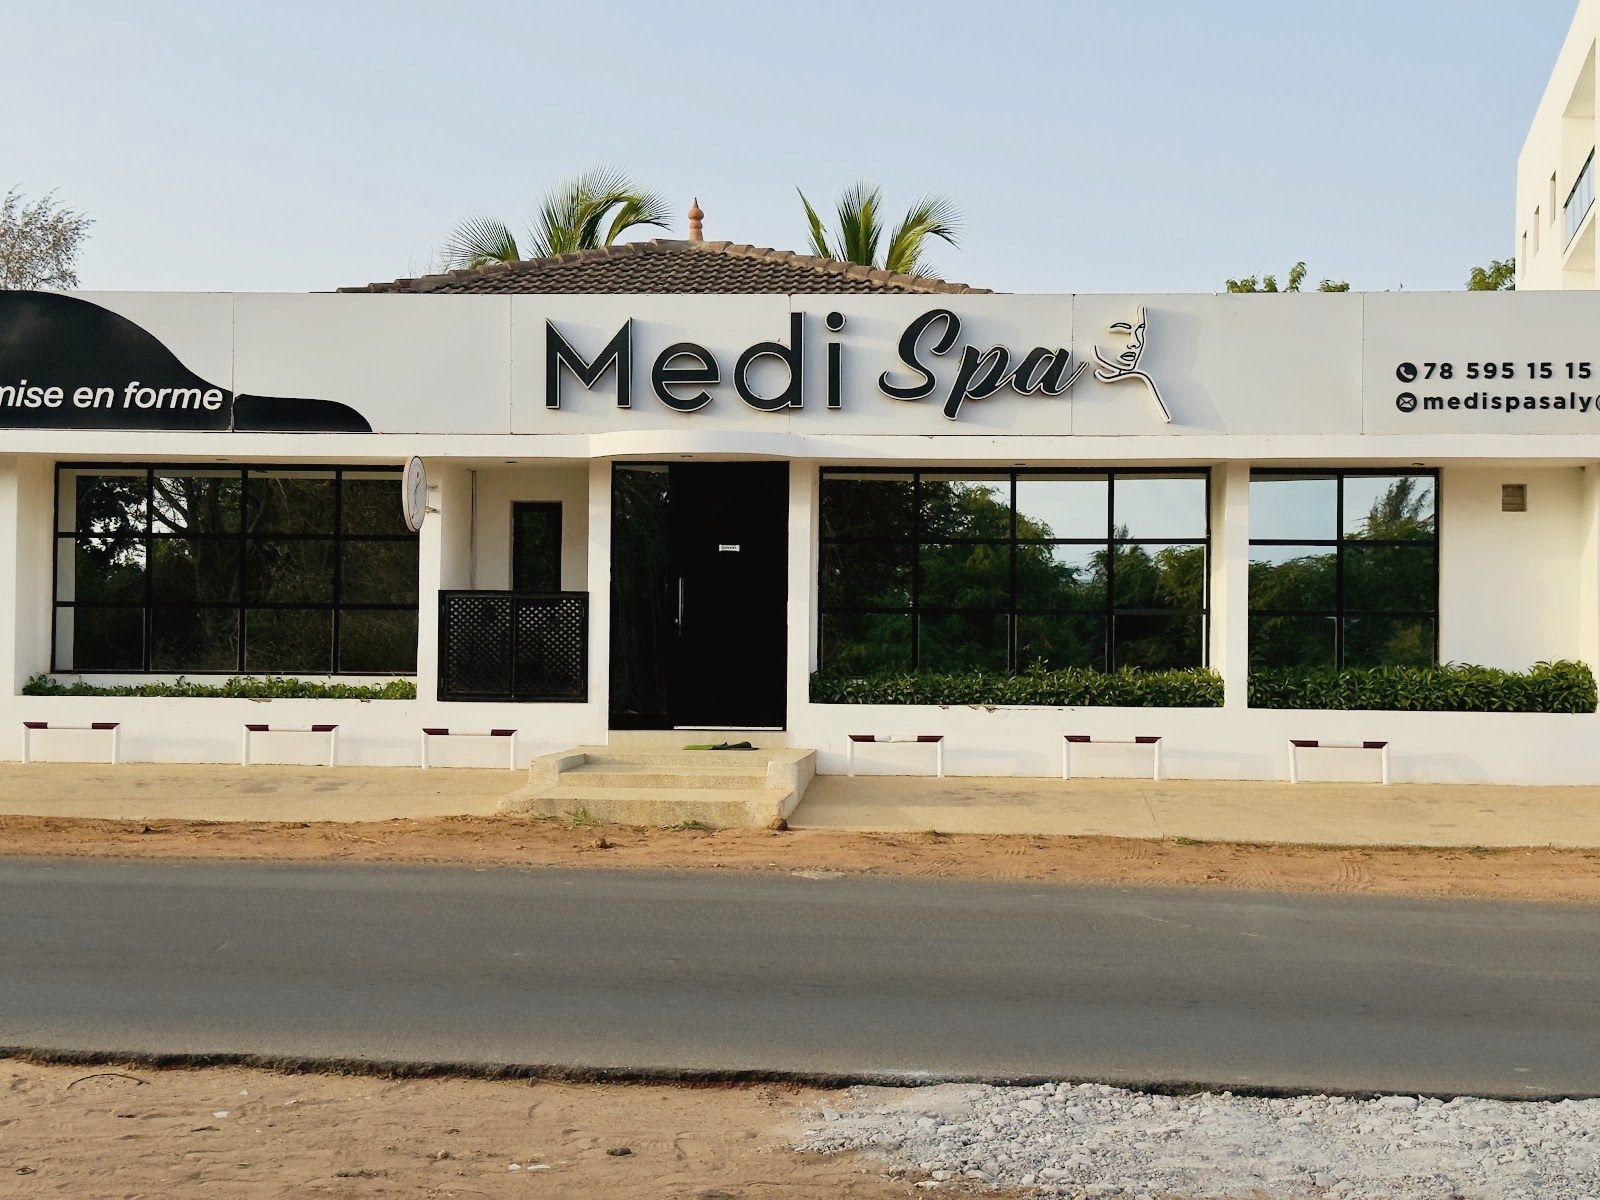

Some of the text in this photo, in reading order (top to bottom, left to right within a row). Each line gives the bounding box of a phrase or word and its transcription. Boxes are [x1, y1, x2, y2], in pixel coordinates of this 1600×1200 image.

[544, 307, 1087, 420] Medi Spa
[1423, 362, 1591, 379] 78 595 15 15
[73, 386, 114, 409] en
[123, 381, 223, 410] forme
[1423, 391, 1600, 413] medispasaly
